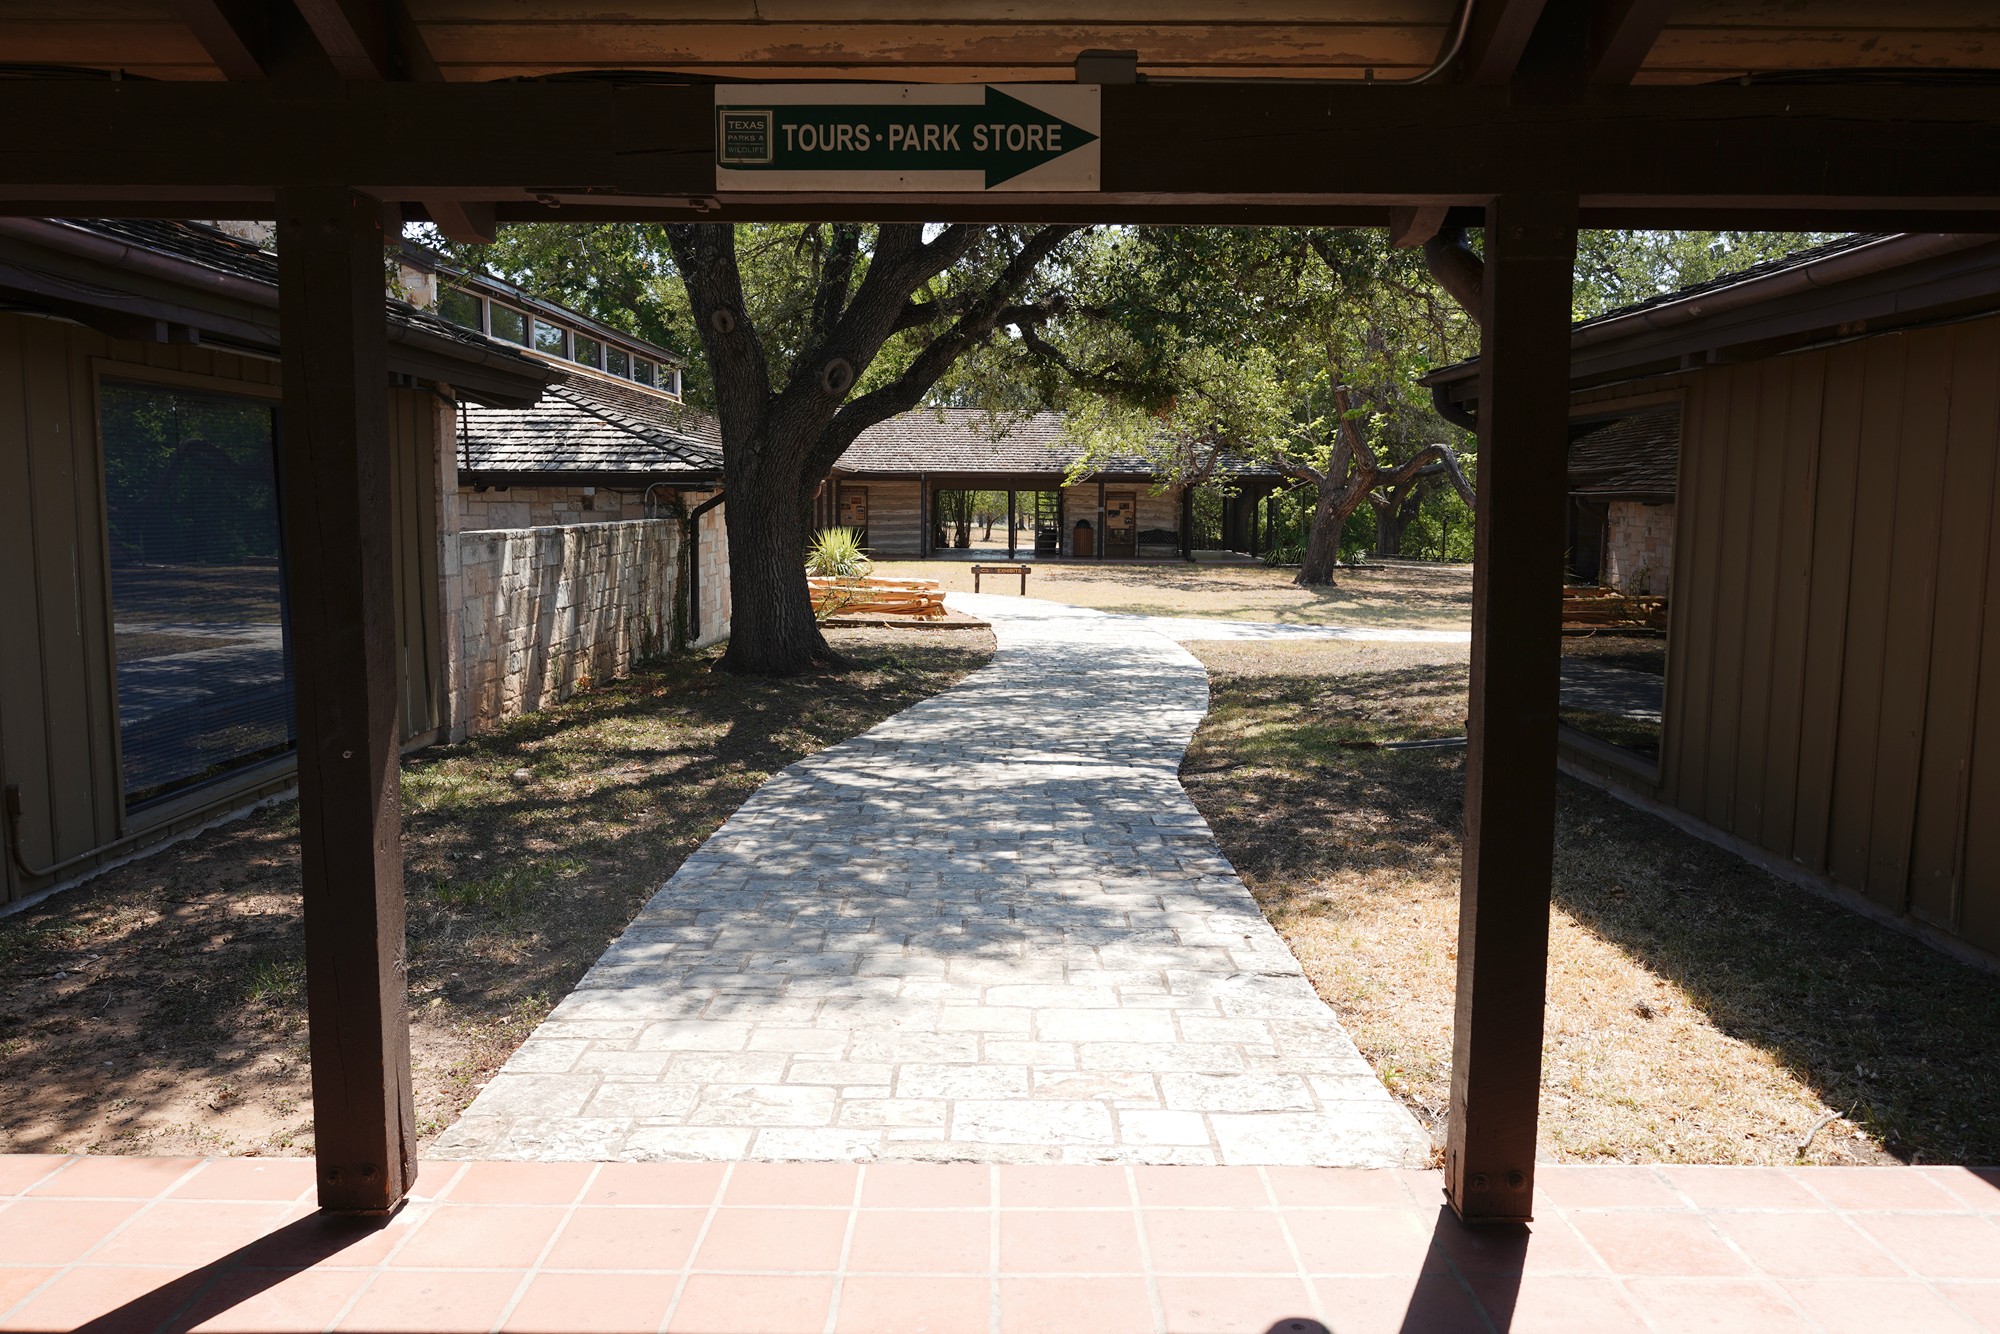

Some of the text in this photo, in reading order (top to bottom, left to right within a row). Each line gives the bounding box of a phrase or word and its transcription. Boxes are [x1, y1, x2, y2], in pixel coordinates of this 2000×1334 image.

[728, 121, 764, 129] TEXAS
[782, 124, 1062, 151] TOURS PARK STORE
